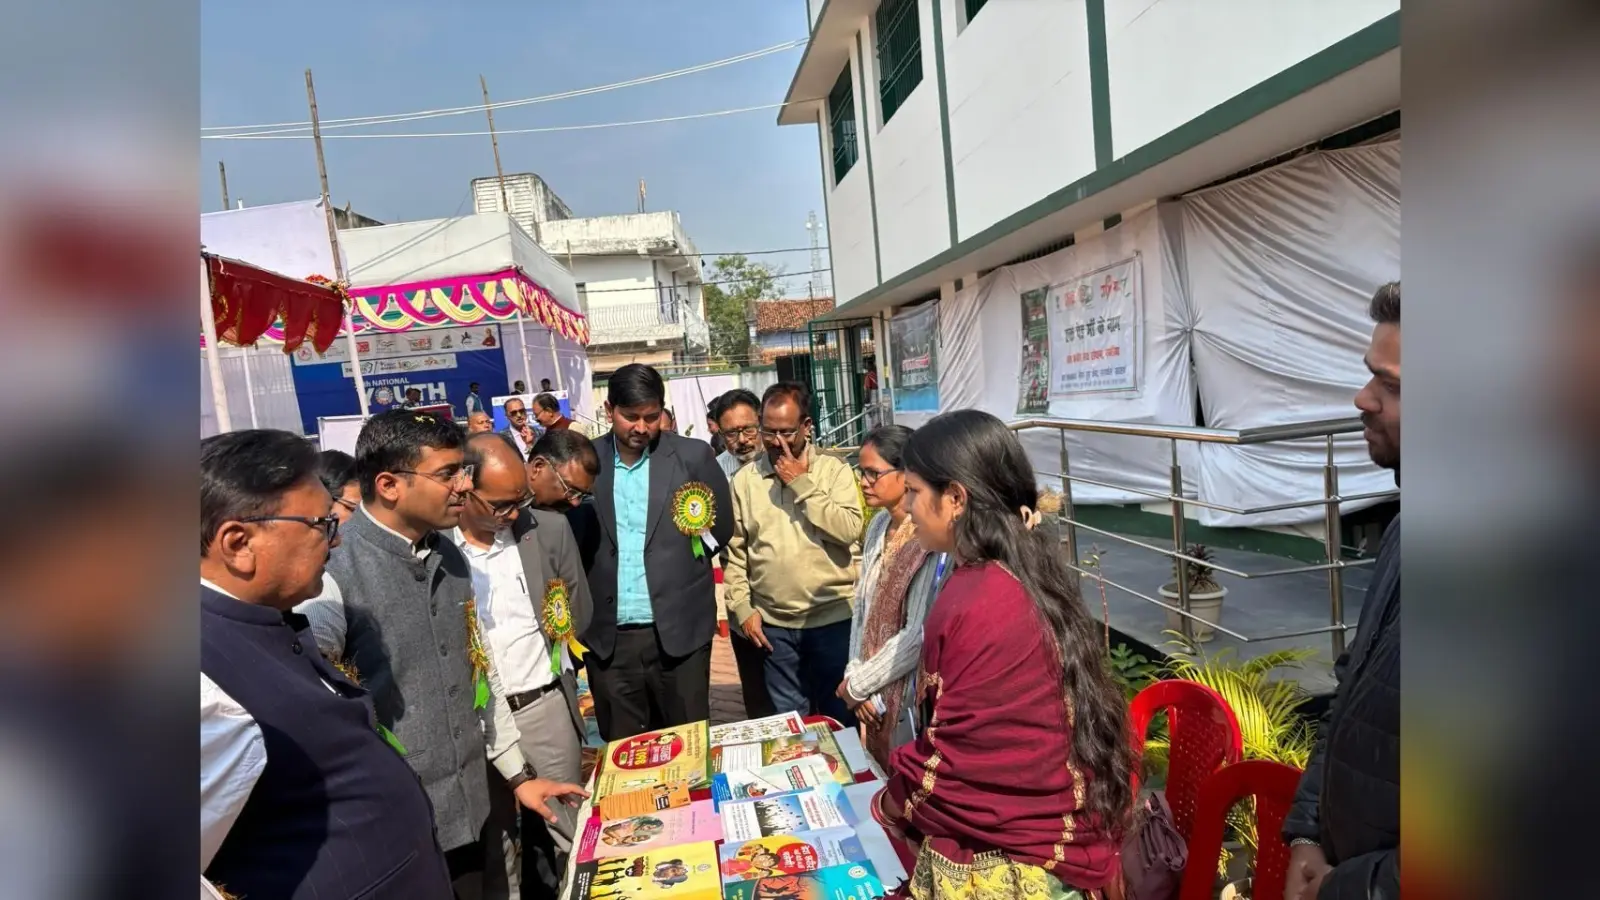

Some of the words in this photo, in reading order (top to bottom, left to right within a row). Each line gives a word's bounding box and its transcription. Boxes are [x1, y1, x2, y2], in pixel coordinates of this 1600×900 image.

[372, 376, 410, 387] NATIONAL
[357, 382, 447, 406] YOUTH
[634, 747, 647, 766] 1098
